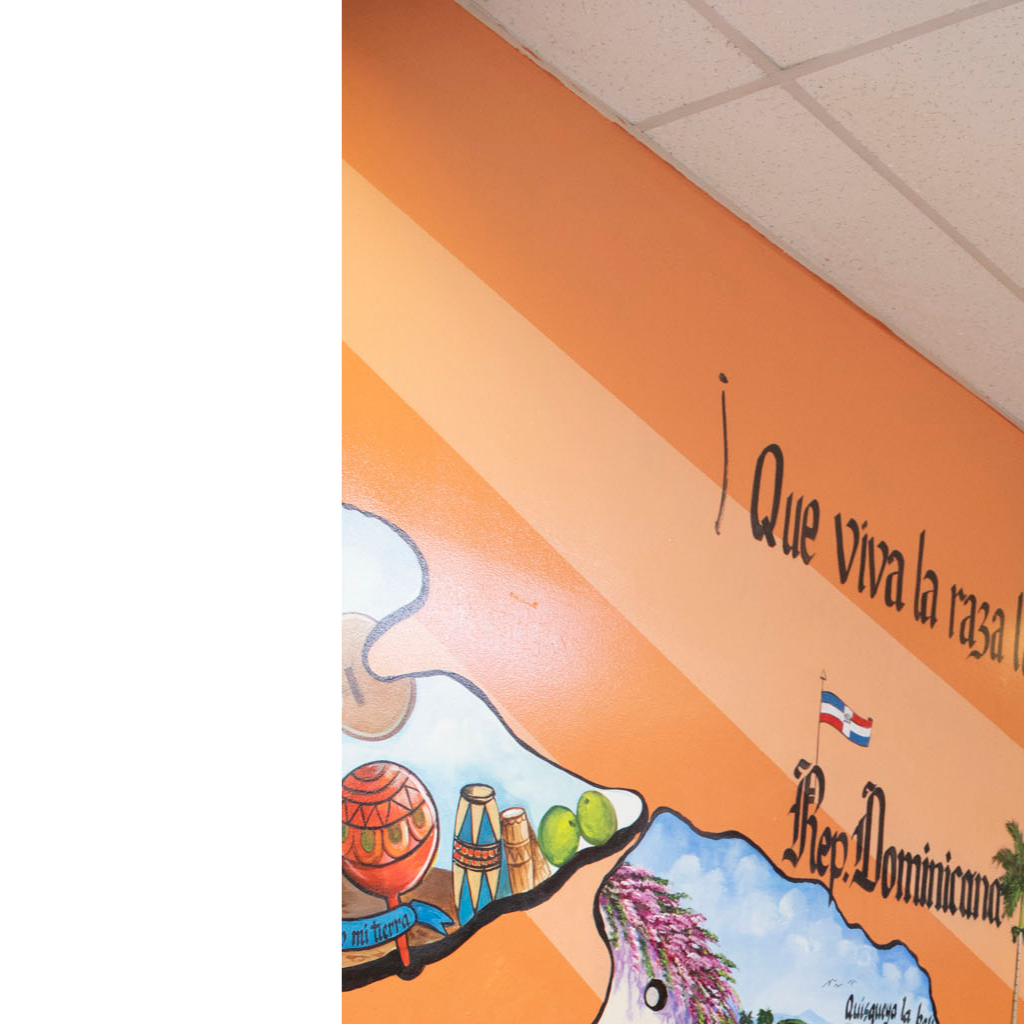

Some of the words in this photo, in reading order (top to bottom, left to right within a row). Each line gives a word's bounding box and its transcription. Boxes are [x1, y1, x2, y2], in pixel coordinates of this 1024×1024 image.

[834, 512, 905, 612] viva
[914, 529, 939, 629] la
[949, 583, 1005, 663] raza
[782, 758, 849, 907] Rep.
[850, 780, 1002, 928] Dominicana
[351, 923, 369, 947] mi
[371, 914, 410, 943] tierra
[901, 995, 911, 1023] la
